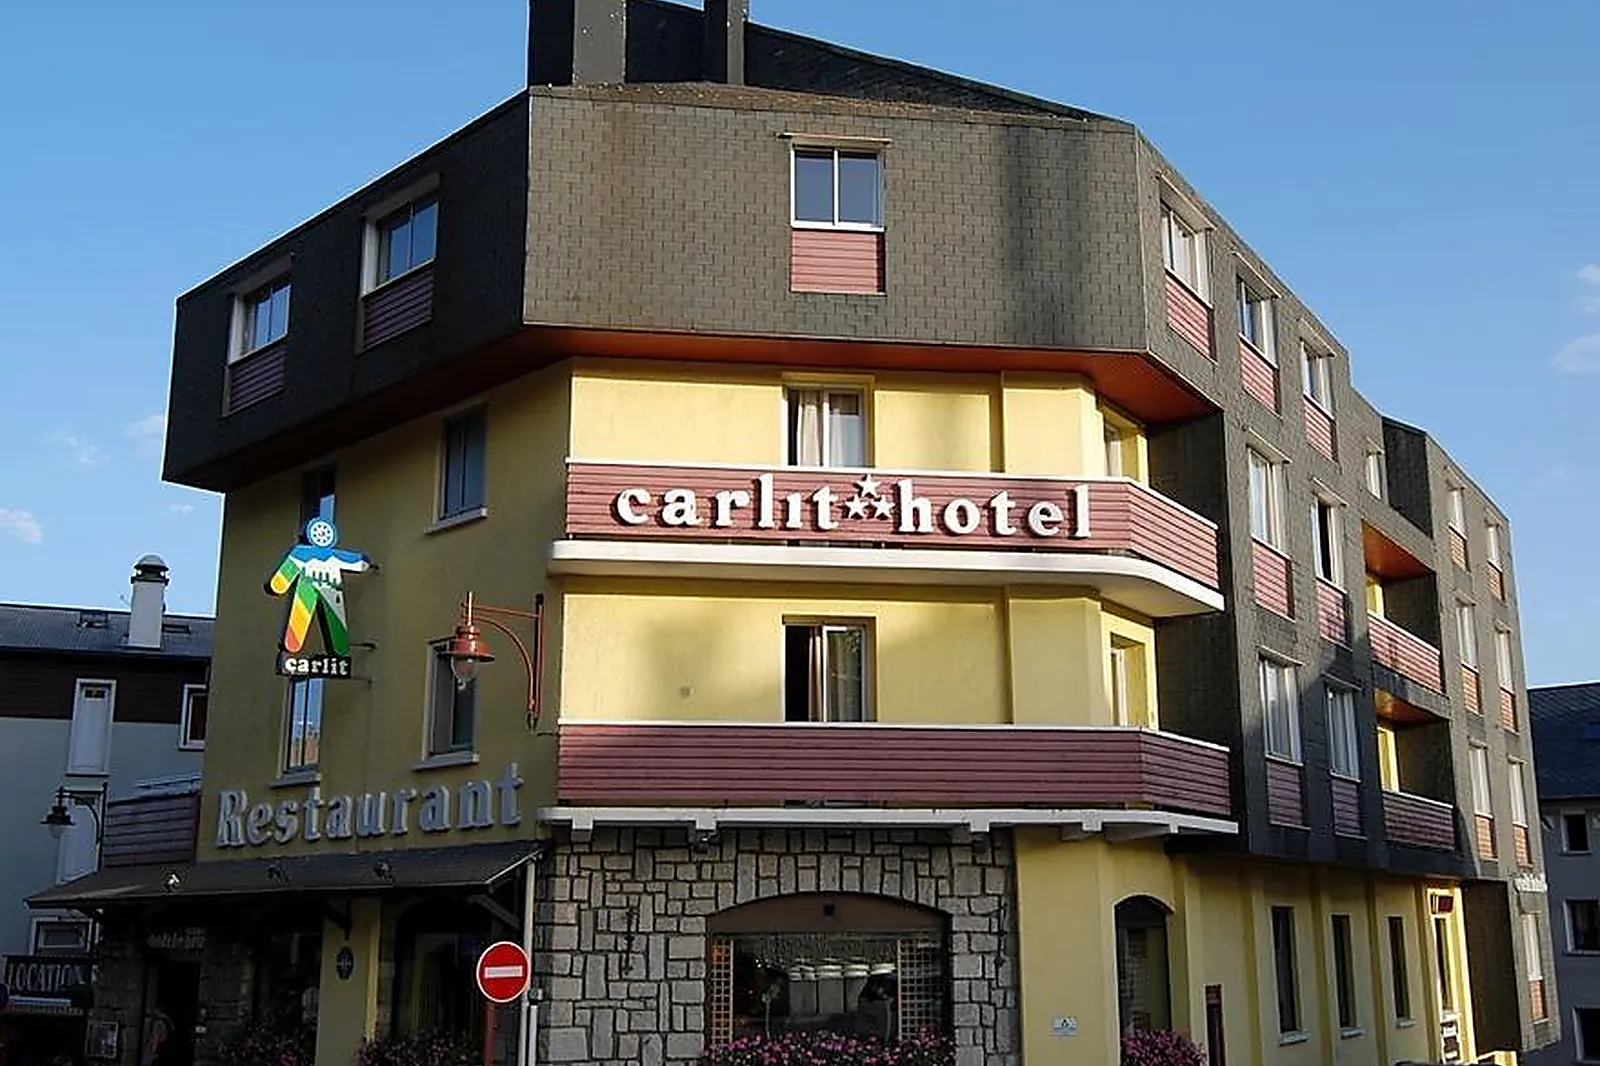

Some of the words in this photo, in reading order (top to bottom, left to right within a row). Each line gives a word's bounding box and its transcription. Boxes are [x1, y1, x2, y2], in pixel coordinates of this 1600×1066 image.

[896, 479, 1092, 539] hotel
[284, 657, 349, 676] carlit
[215, 763, 524, 848] Restaurant
